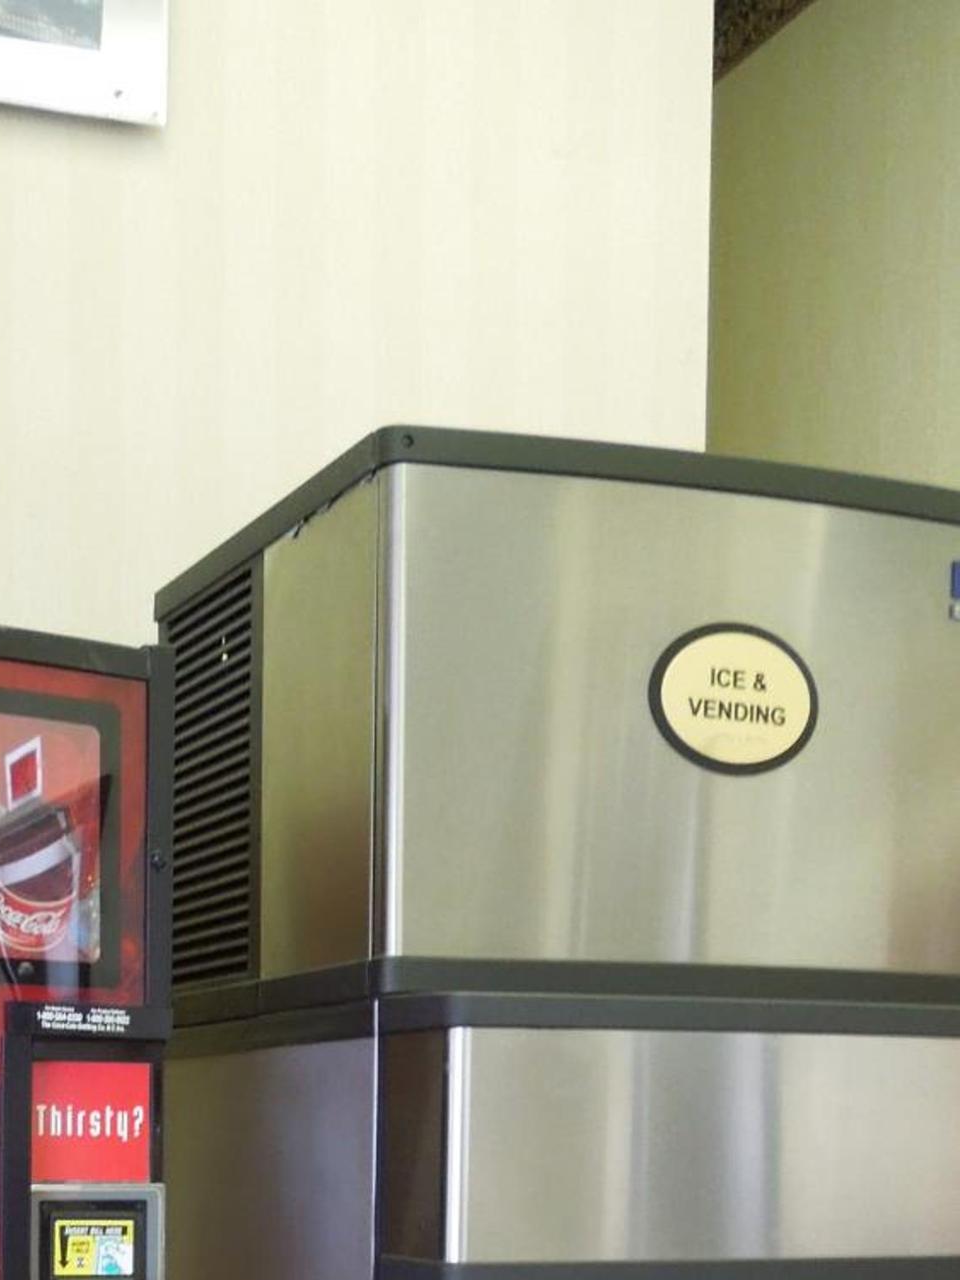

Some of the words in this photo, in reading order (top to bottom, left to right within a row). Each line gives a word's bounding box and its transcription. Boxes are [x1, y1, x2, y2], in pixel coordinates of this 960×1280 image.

[710, 667, 746, 690] ICE
[753, 672, 767, 692] &
[688, 697, 786, 727] VENDING
[36, 1104, 144, 1143] Thirsty?
